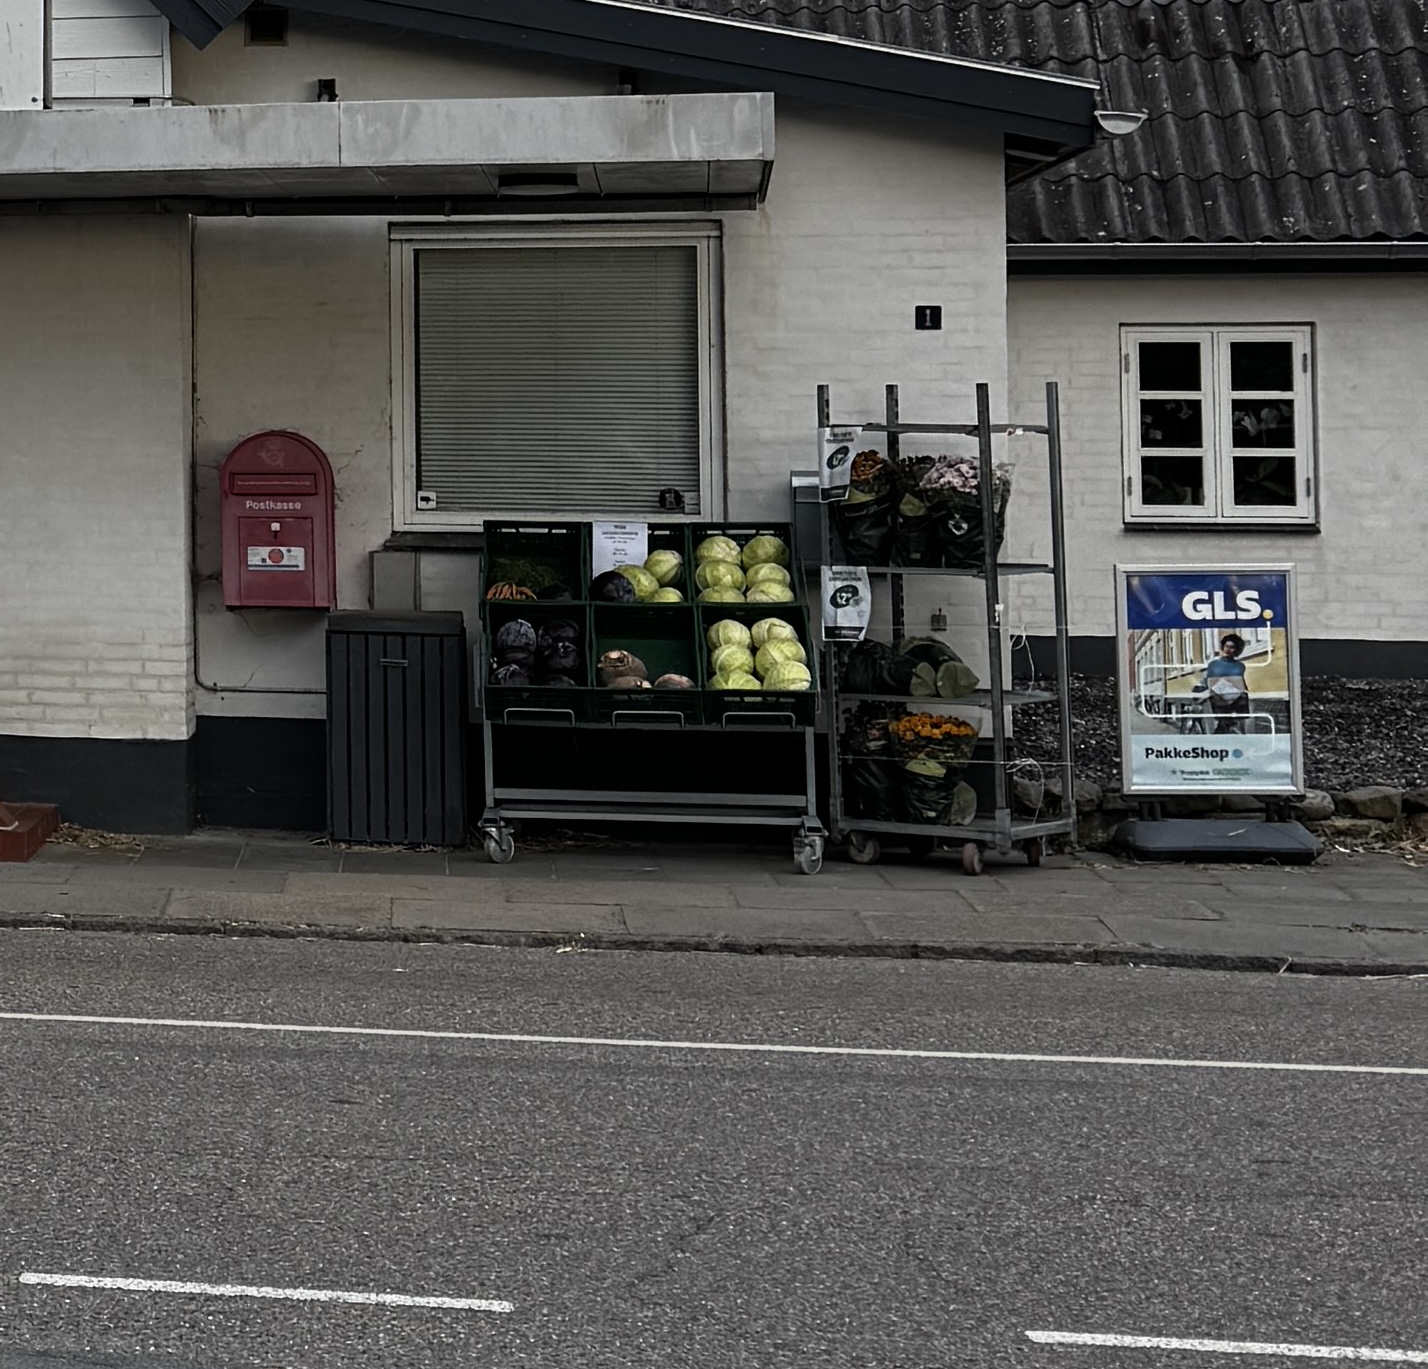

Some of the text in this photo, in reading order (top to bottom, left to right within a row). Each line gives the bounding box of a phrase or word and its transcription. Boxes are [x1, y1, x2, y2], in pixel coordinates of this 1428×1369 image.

[924, 308, 933, 327] 1
[245, 500, 302, 510] Postkasse
[1144, 746, 1230, 762] PakkeShop
